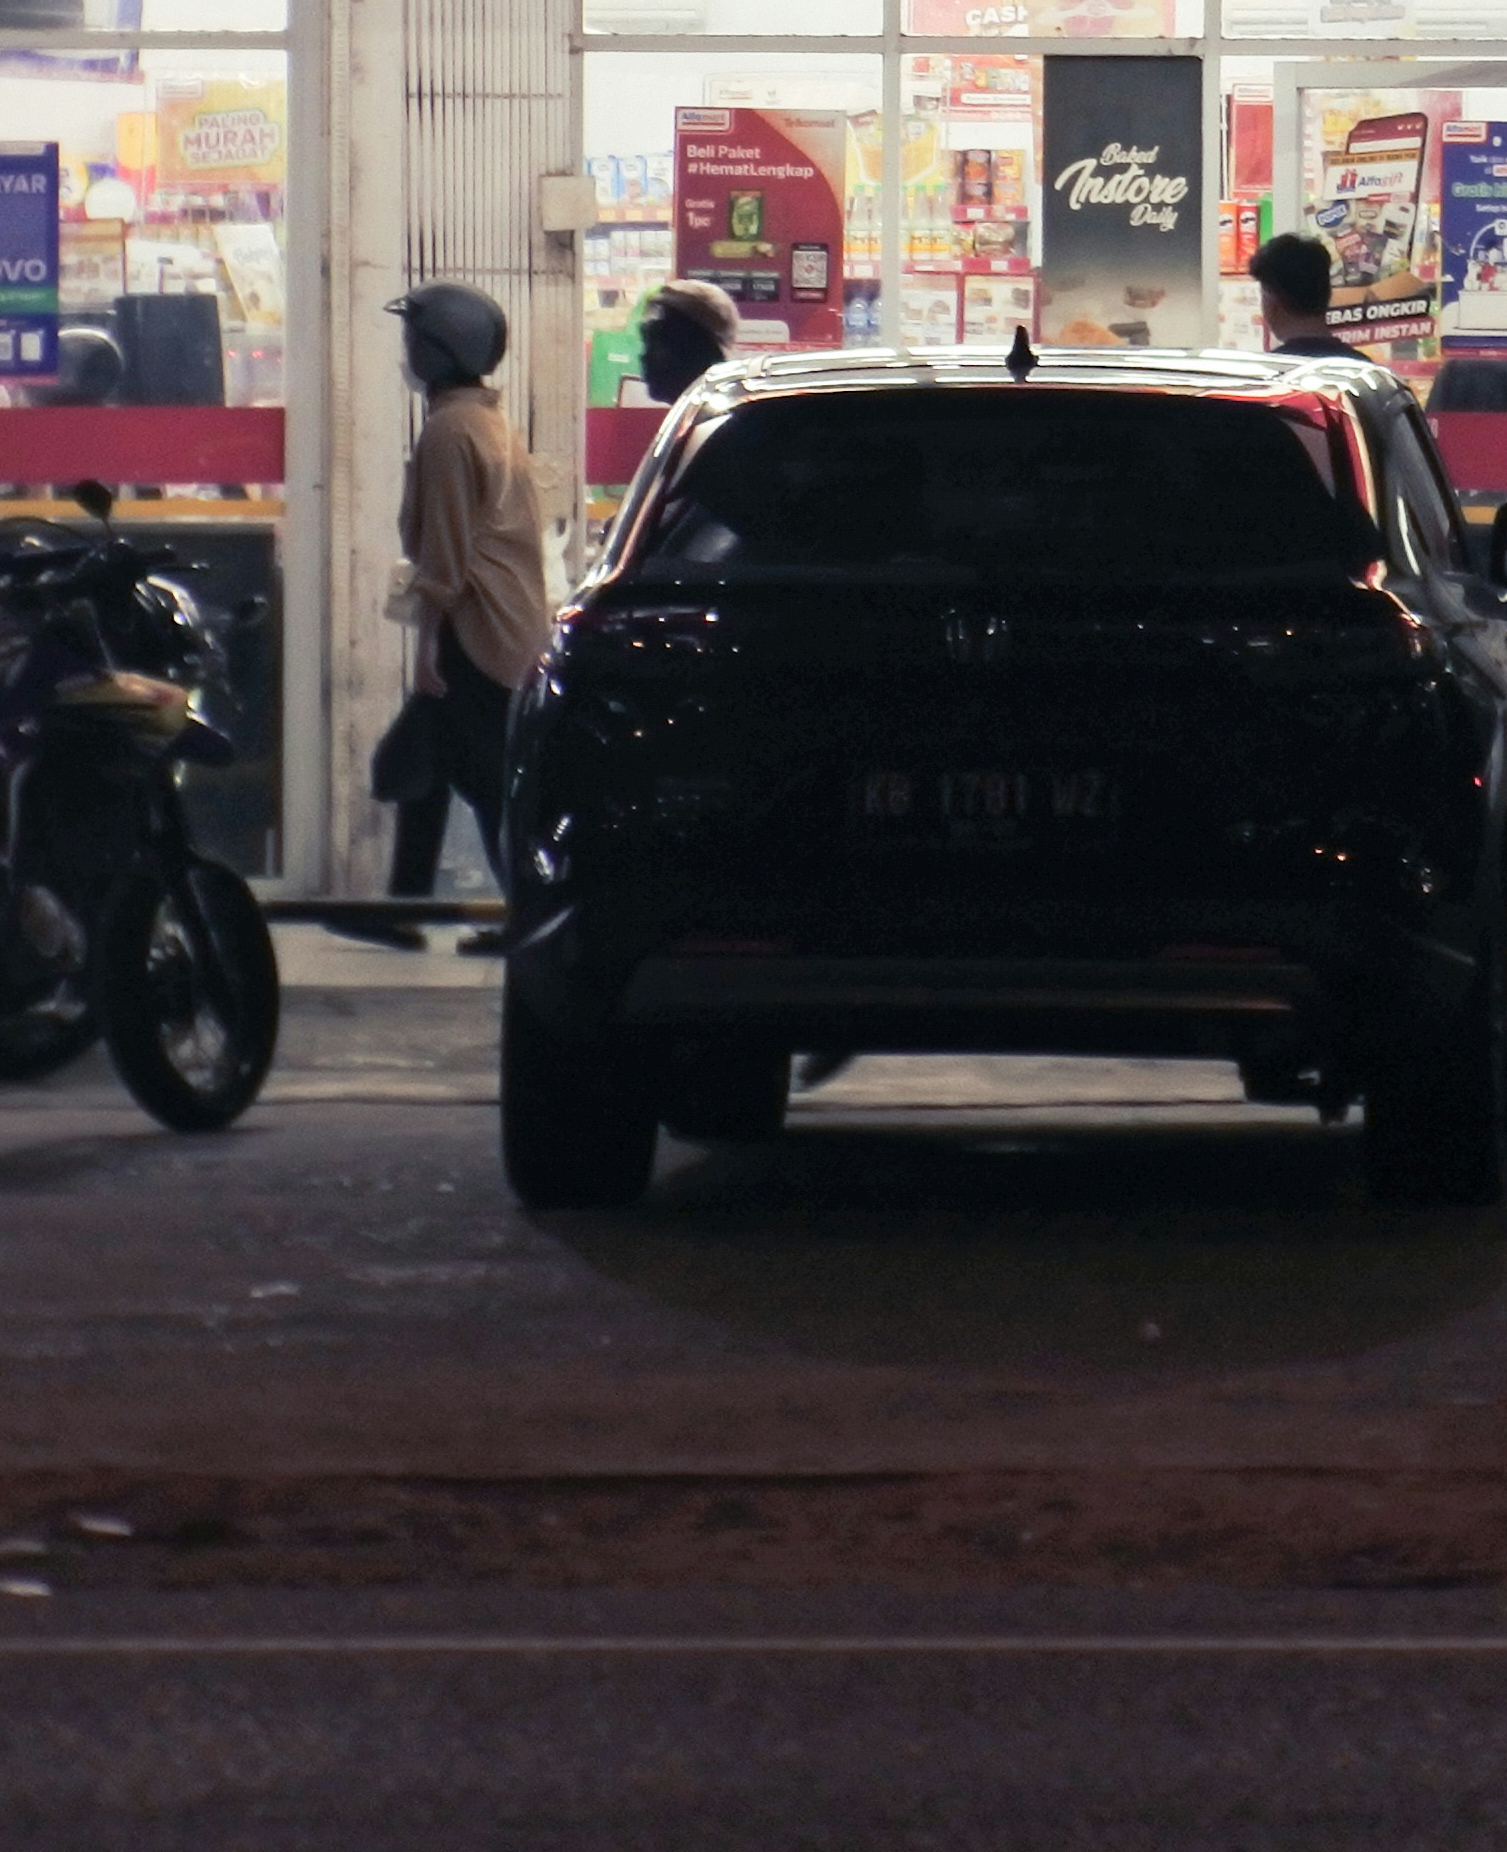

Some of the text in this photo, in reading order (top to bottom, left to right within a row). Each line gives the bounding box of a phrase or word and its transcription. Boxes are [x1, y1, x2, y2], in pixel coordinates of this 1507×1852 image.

[183, 127, 276, 149] MURAH
[687, 145, 761, 160] Beli Paket
[1099, 142, 1161, 166] Baked
[687, 162, 815, 180] #HematLengkap
[1054, 158, 1189, 211] Instore
[1129, 203, 1179, 232] Daily
[1366, 299, 1428, 320] ONGKIR
[1374, 321, 1432, 340] INSTAN
